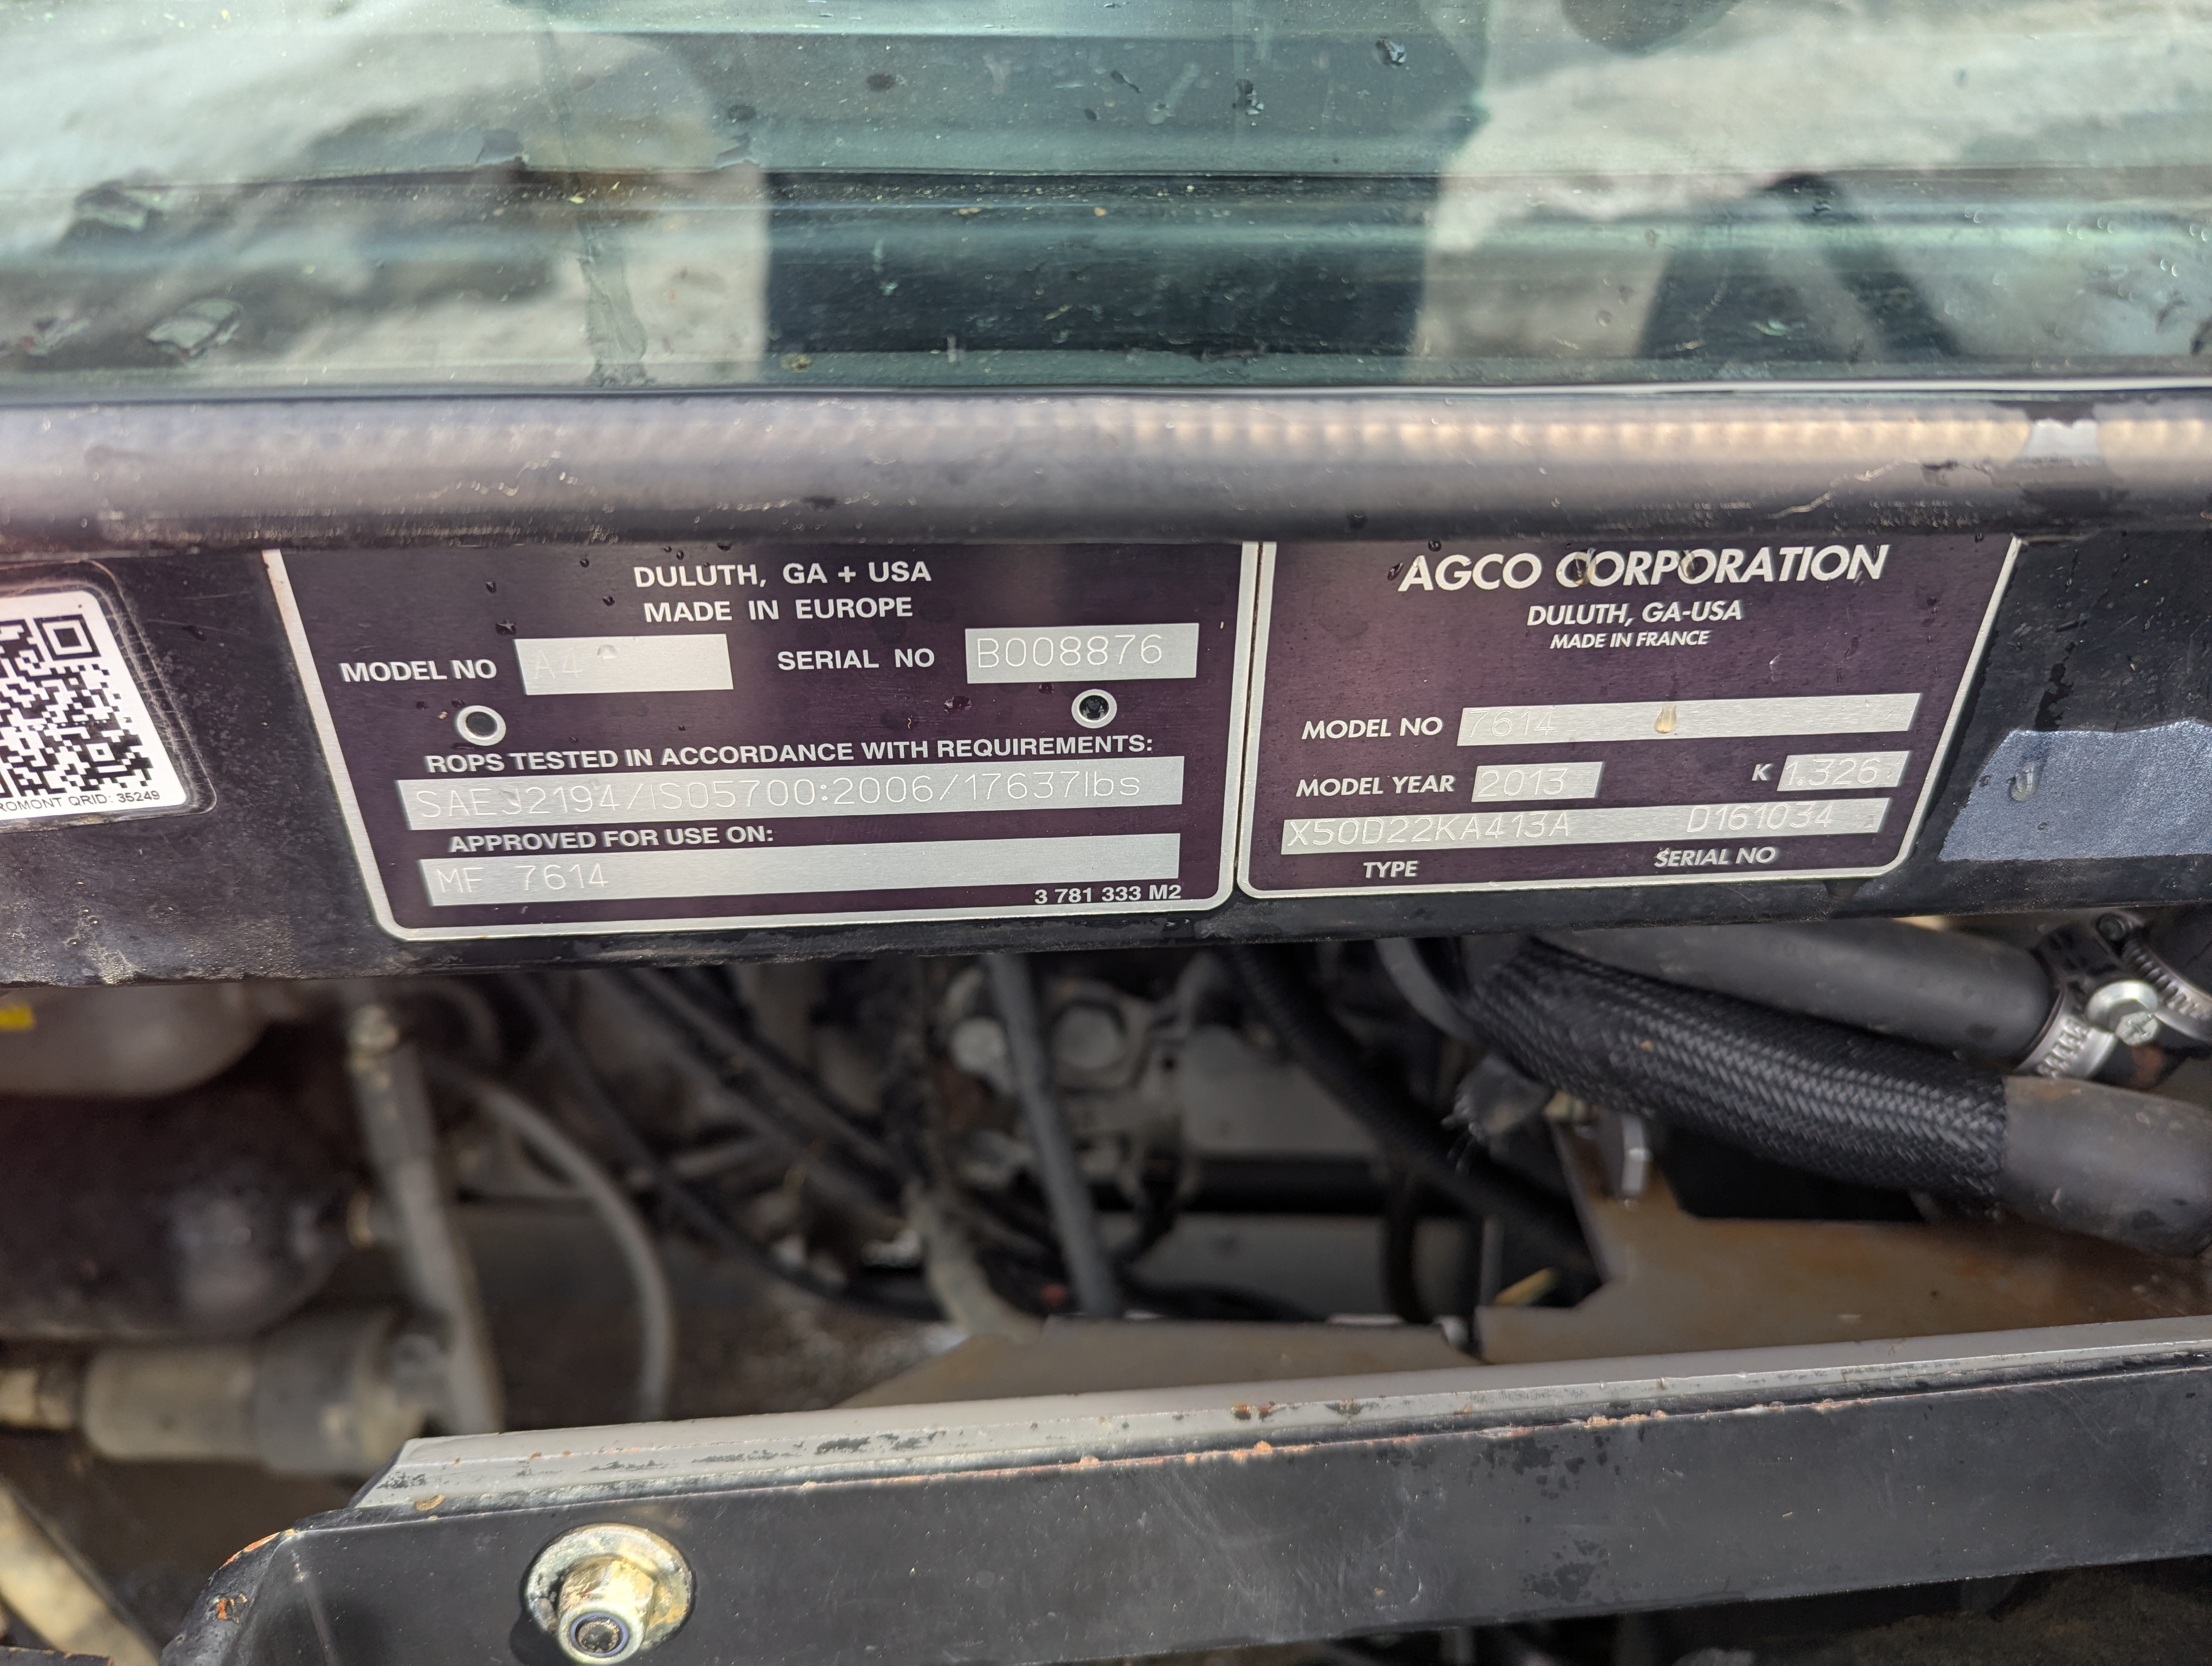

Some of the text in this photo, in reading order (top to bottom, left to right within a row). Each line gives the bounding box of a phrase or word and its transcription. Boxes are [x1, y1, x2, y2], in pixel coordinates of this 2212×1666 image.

[633, 564, 767, 588] DULUTH,
[782, 563, 828, 584] GA
[869, 561, 932, 582] USA
[1398, 544, 1890, 592] AGCO CORPORATION
[643, 597, 913, 623] MADE IN EUROPE
[1527, 600, 1744, 627] DULUTH, GA-USA
[976, 634, 1163, 669] B008876
[1549, 630, 1711, 649] MADE IN FRANCE
[339, 659, 497, 682] MODEL NO
[777, 648, 935, 670] SERIAL NO
[1301, 717, 1443, 740] MODEL NO
[1468, 707, 1555, 738] 7614
[425, 734, 1154, 773] ROPS TESTED IN ACCORDANCE WITH REQUIREMENTS:
[1477, 768, 1568, 798] 2013
[1751, 763, 1772, 782] K
[1296, 774, 1456, 797] MODEL YEAR
[68, 794, 113, 806] QRID:
[116, 790, 160, 803] 35249
[448, 825, 774, 853] APPROVED FOR USE ON:
[1654, 847, 1777, 868] SERIAL NO
[435, 862, 609, 894] MF 7614
[1363, 861, 1419, 879] TYPE
[1034, 884, 1182, 904] 3 781 333 M2
